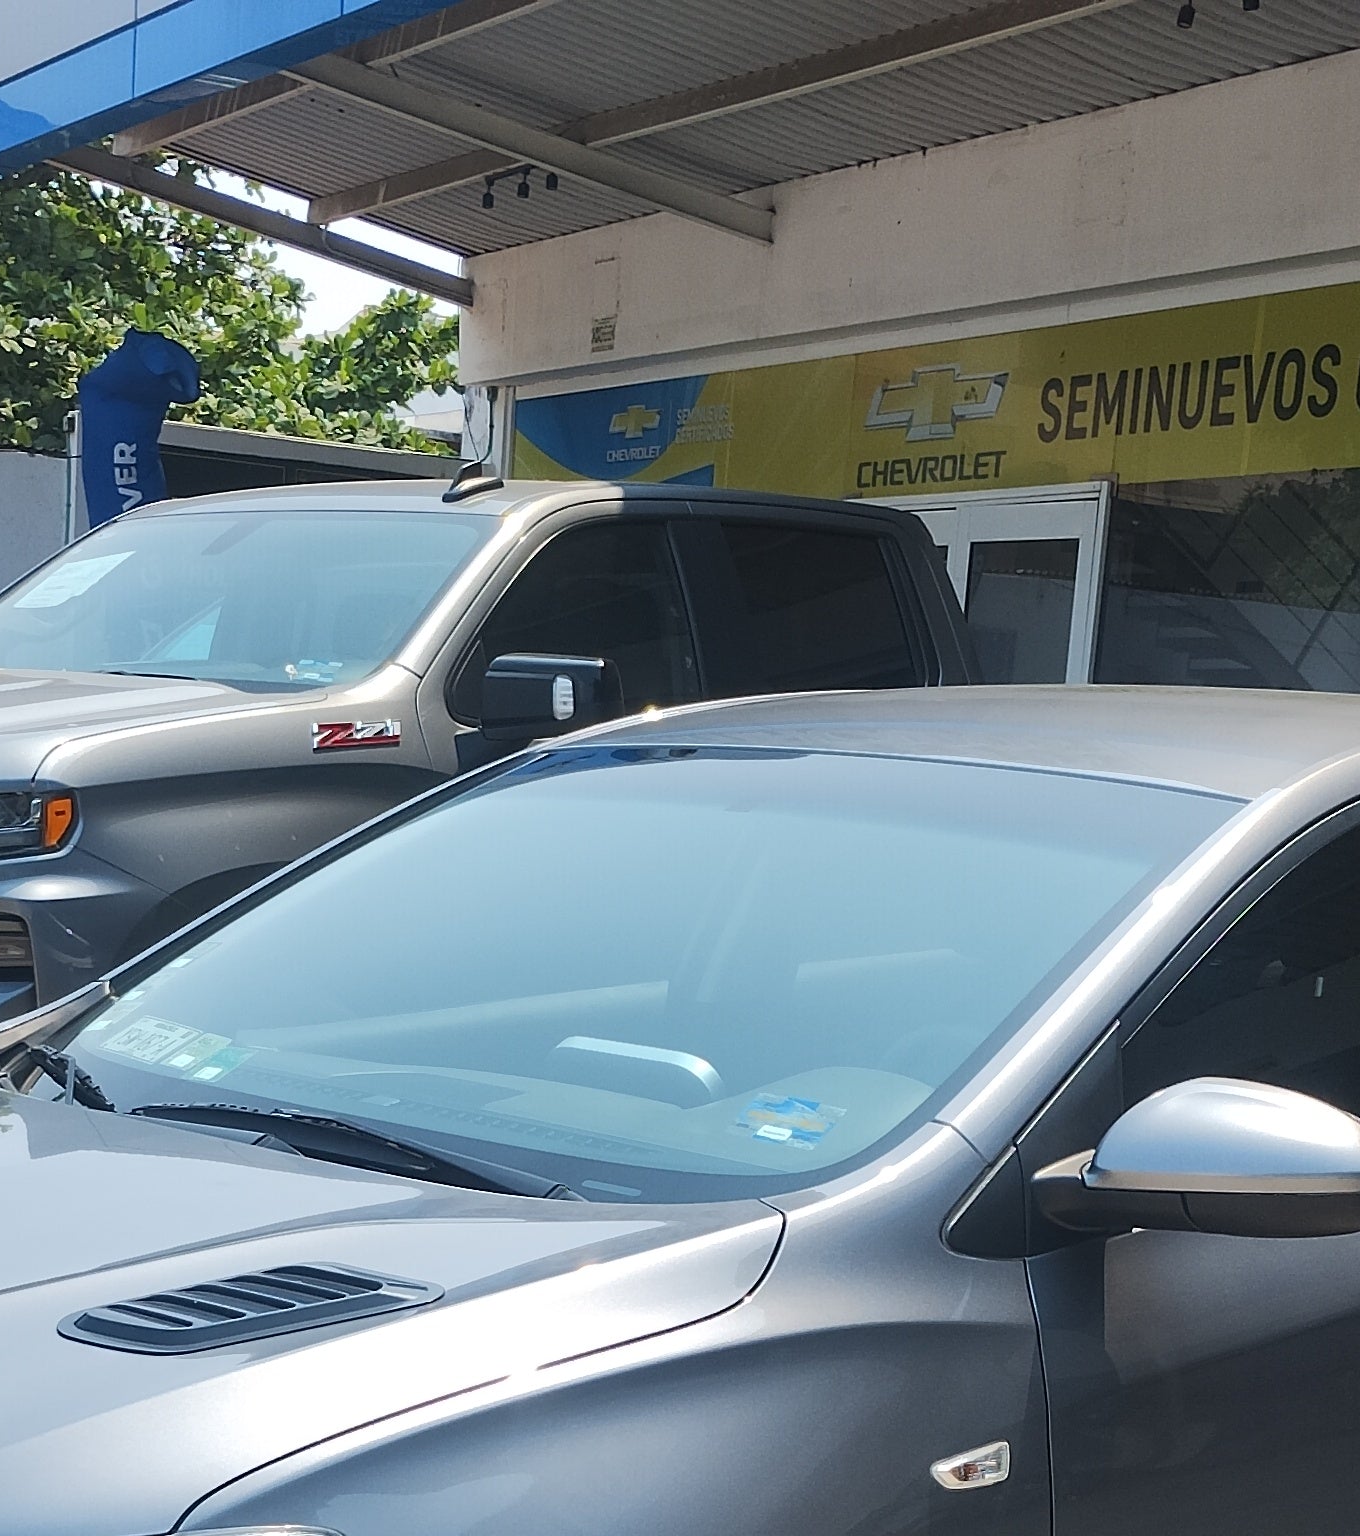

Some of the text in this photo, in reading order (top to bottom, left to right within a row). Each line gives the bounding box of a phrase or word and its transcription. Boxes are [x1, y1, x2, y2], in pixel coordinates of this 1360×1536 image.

[1037, 343, 1341, 443] SEMINUEVOS
[606, 445, 662, 463] CHEVROLET
[856, 450, 1007, 489] CHEVROLET
